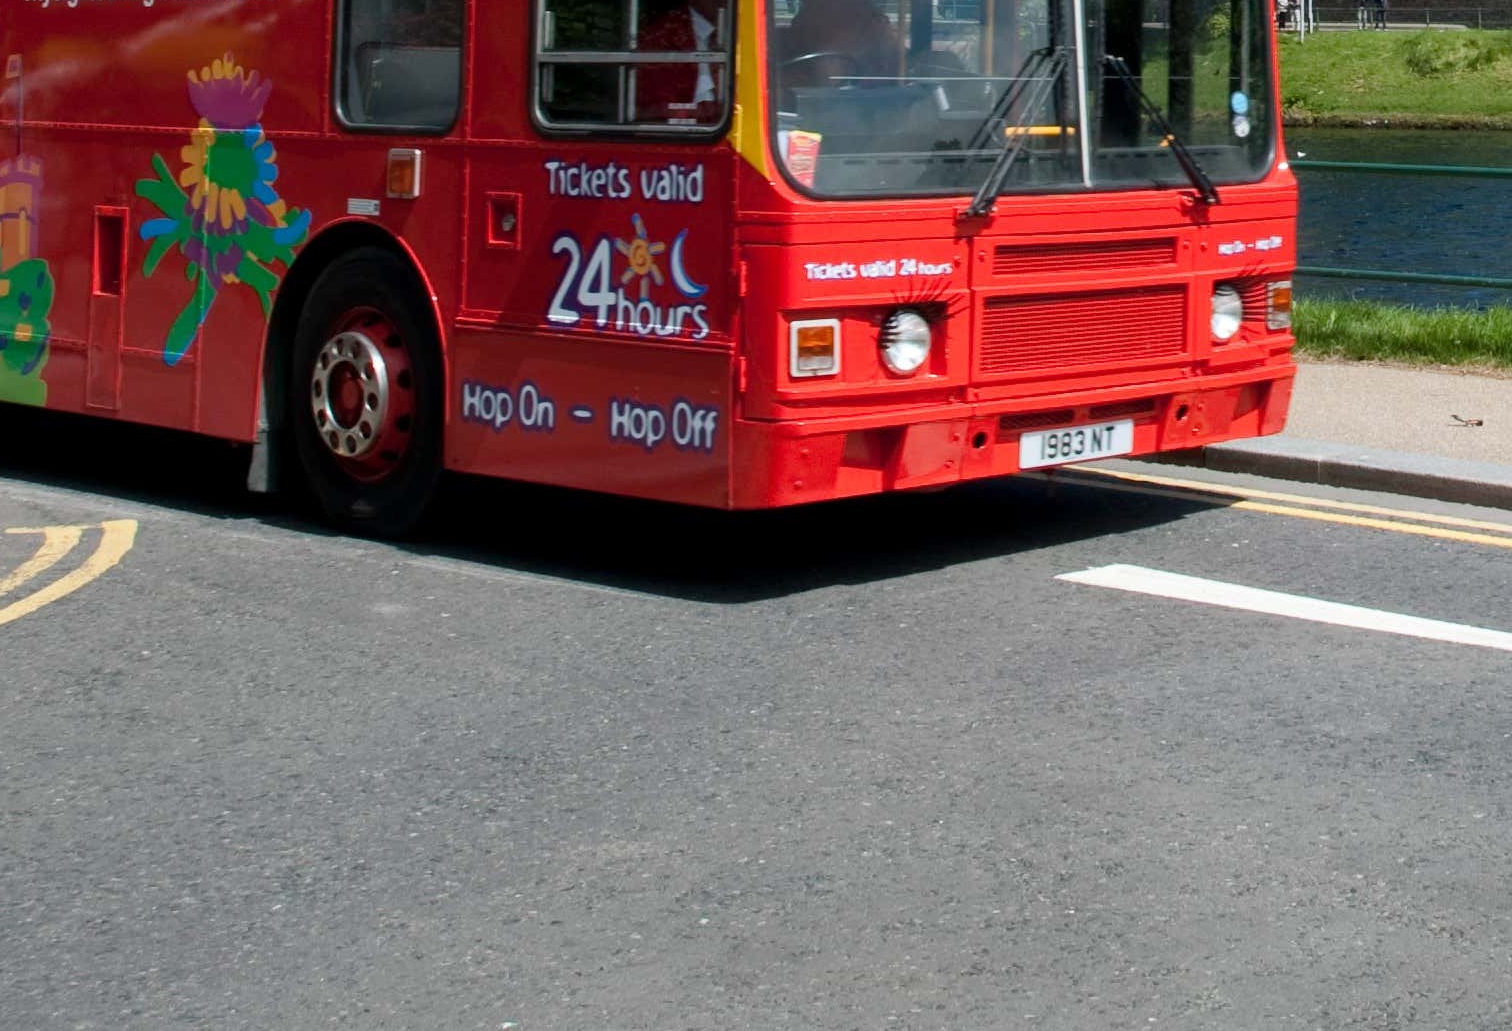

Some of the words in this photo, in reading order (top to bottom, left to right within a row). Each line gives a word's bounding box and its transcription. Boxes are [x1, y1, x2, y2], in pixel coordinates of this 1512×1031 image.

[544, 159, 632, 201] Tickets
[641, 163, 704, 203] valid
[547, 234, 616, 327] 24
[615, 286, 710, 339] hours
[463, 383, 512, 428] Hop
[519, 386, 555, 428] On
[610, 400, 666, 447] Hop
[671, 402, 718, 449] Off
[1040, 430, 1085, 460] 1983
[1090, 426, 1115, 453] NT
